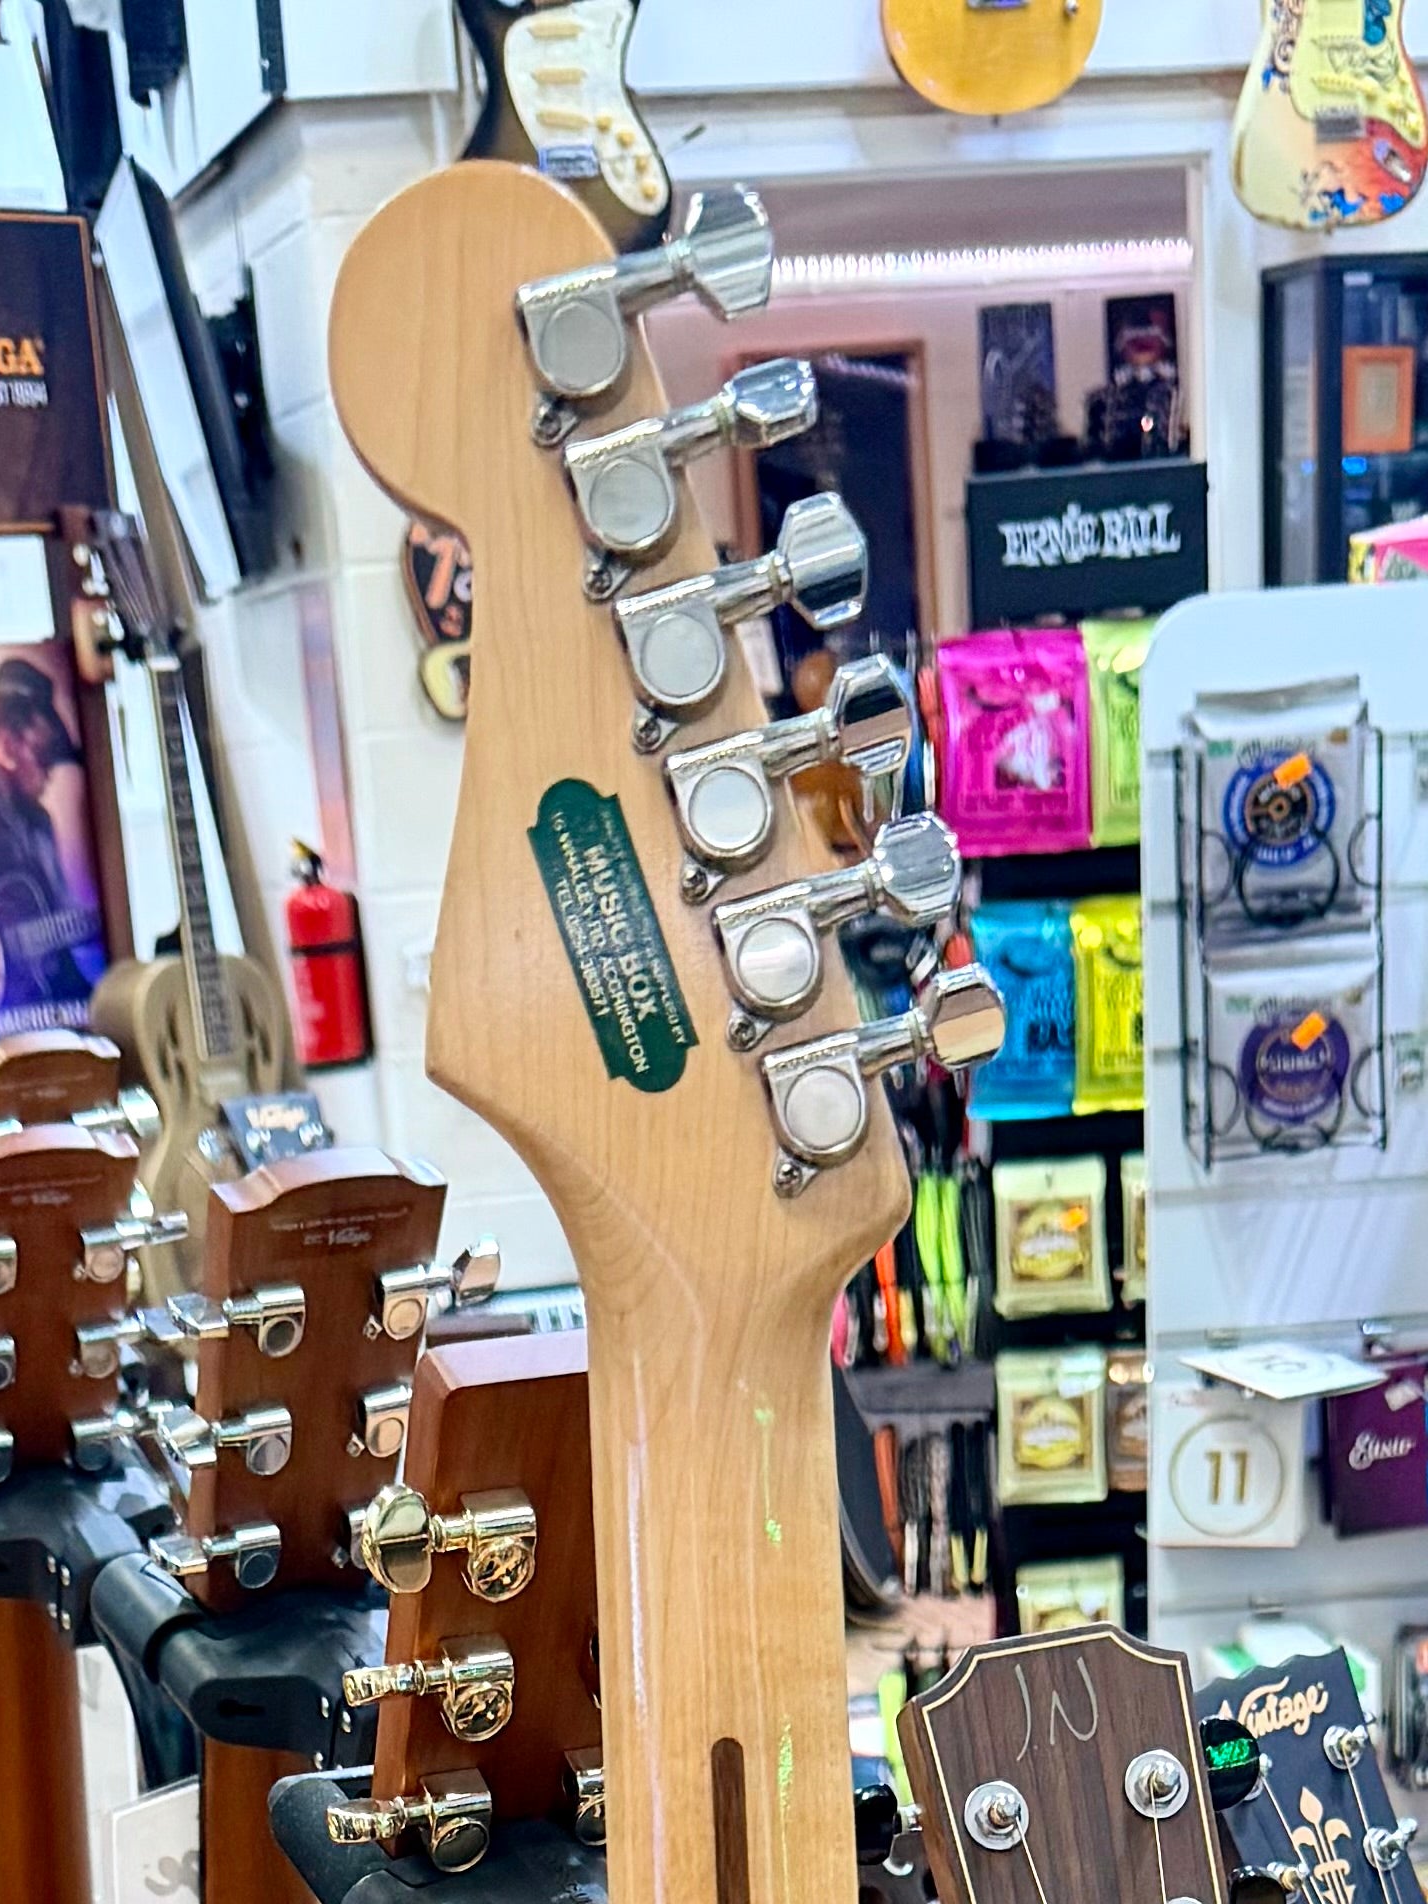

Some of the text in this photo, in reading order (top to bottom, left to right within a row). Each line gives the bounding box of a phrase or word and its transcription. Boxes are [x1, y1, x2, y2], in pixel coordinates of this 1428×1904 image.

[998, 502, 1182, 567] ERNIE BALL
[583, 845, 632, 947] MUSIC
[619, 954, 658, 1021] BOX
[599, 956, 650, 1073] ACCRINGTON
[1205, 1450, 1250, 1505] 11
[1219, 1676, 1329, 1738] Vintage
